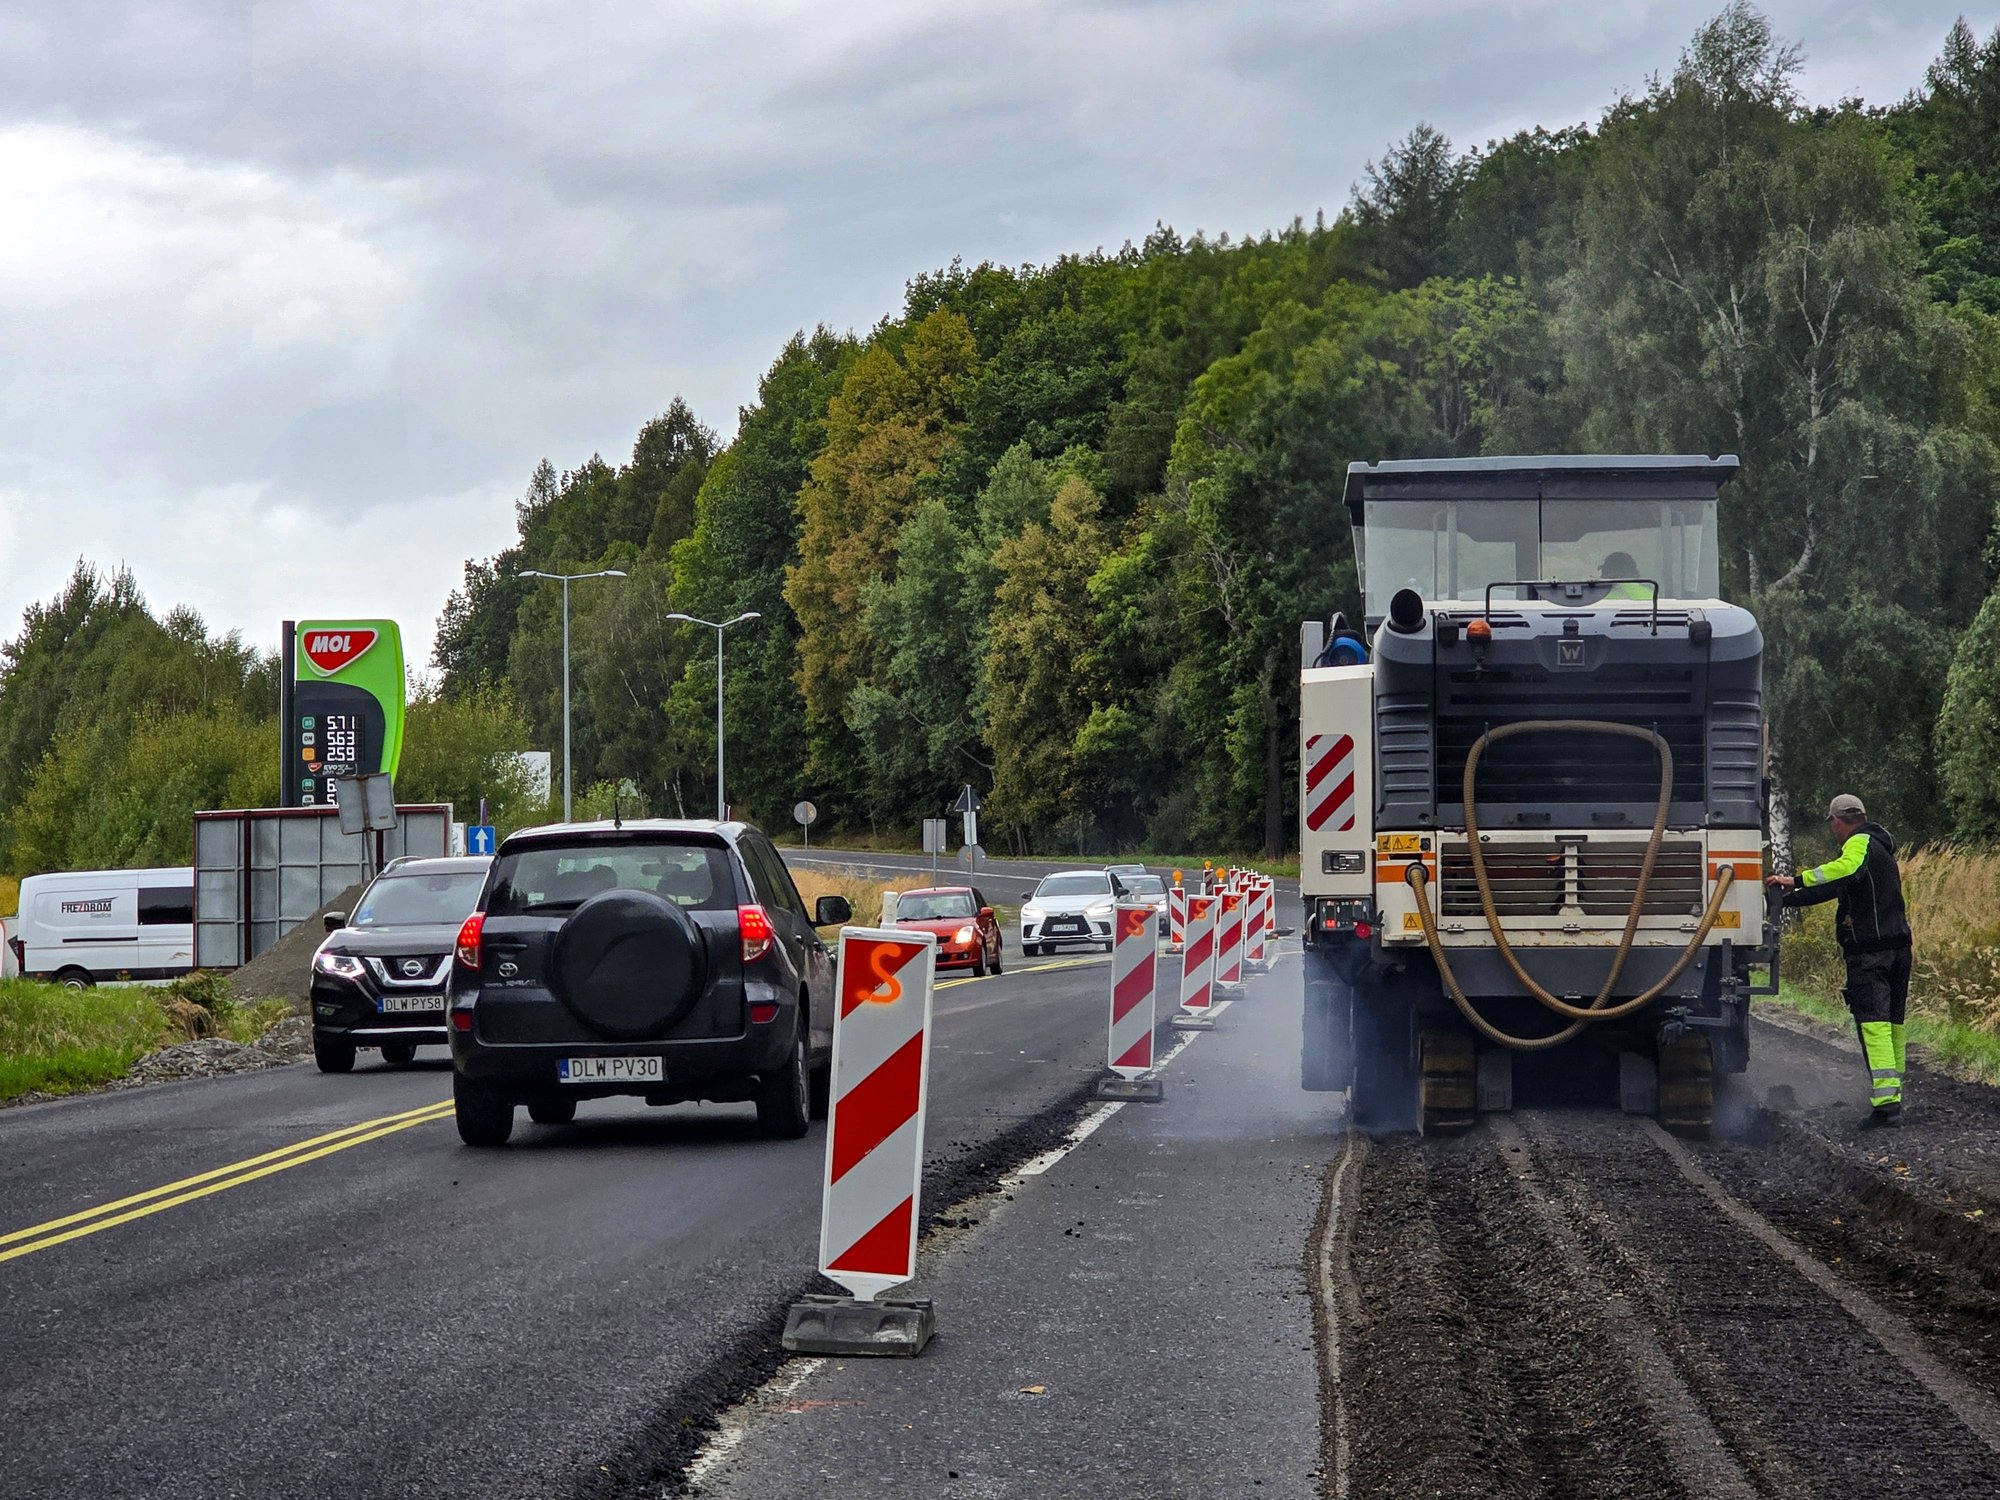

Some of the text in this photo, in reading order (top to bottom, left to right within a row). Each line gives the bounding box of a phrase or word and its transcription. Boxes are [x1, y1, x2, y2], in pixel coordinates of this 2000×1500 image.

[310, 635, 352, 653] MOL
[1562, 646, 1581, 660] W
[1194, 900, 1208, 920] S
[1227, 896, 1238, 912] S
[1125, 910, 1146, 937] S
[856, 943, 902, 1003] S
[385, 999, 408, 1011] DLW
[411, 998, 441, 1009] PY58
[572, 1060, 606, 1077] DLW
[613, 1059, 658, 1076] PV30
